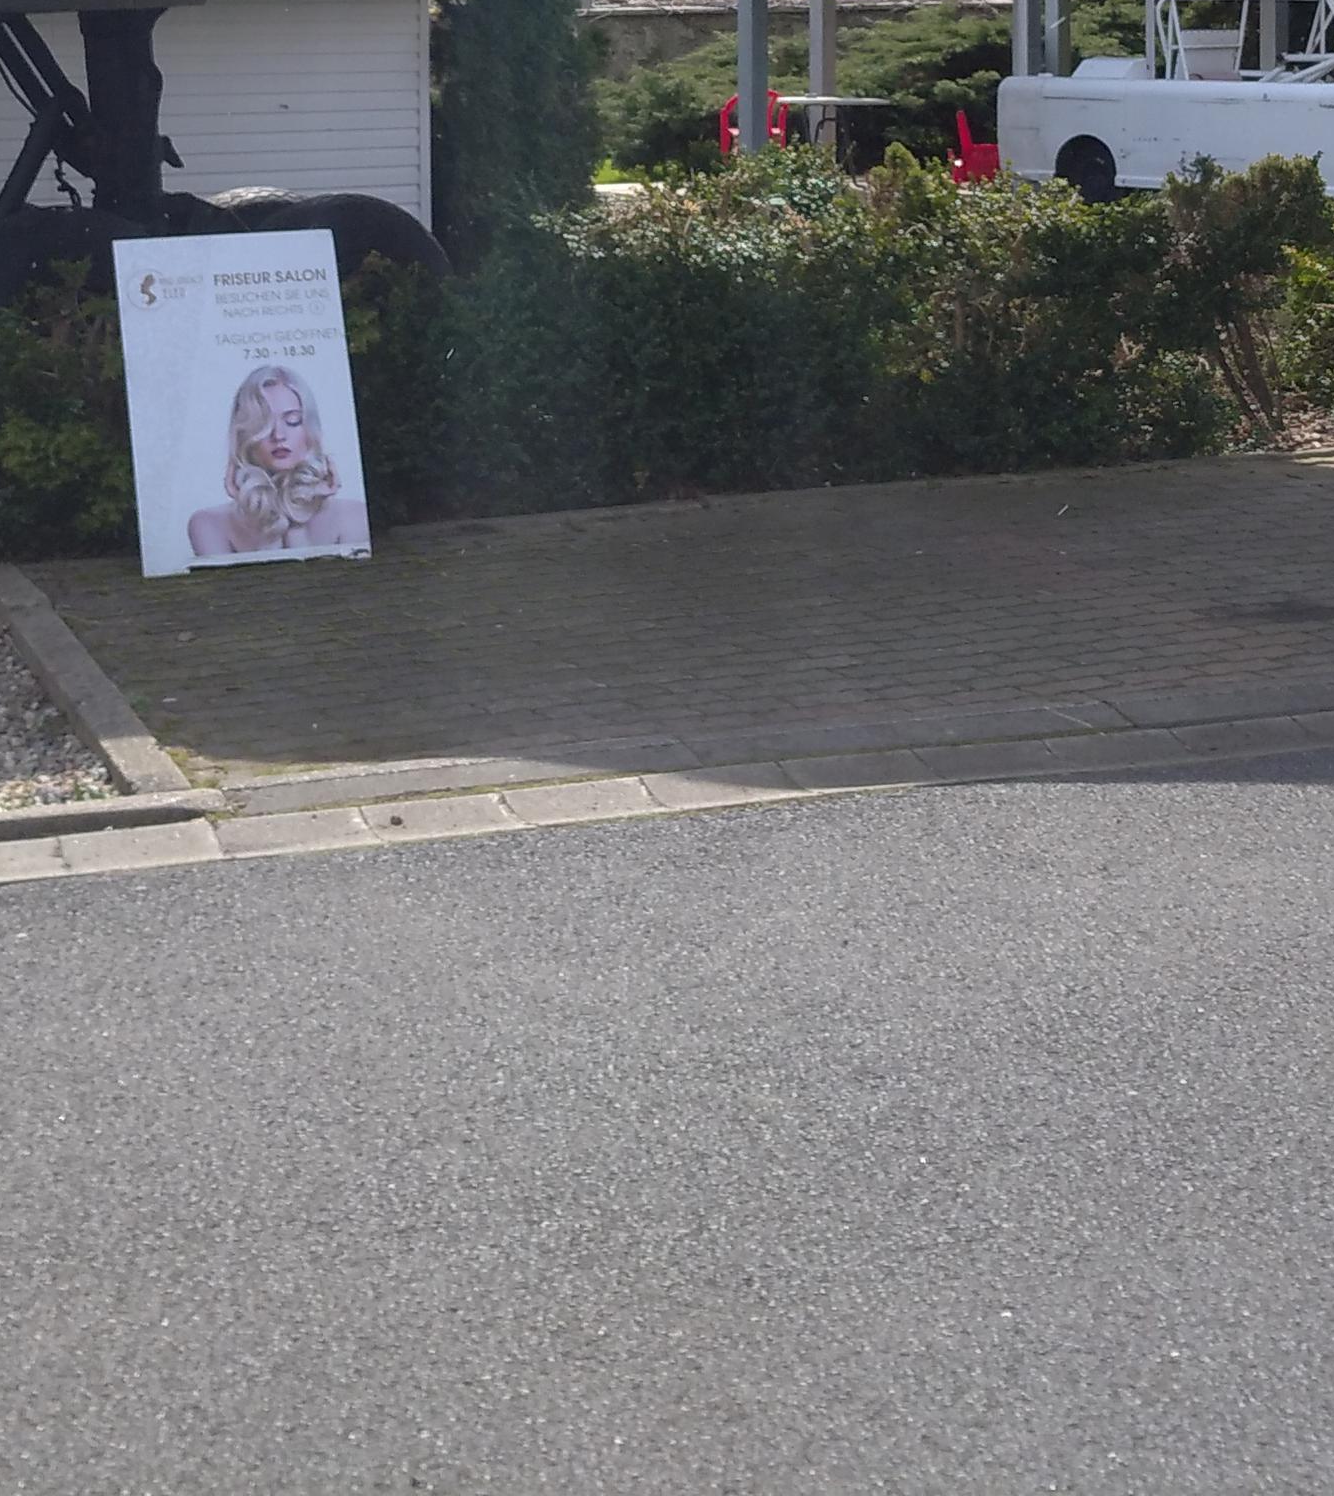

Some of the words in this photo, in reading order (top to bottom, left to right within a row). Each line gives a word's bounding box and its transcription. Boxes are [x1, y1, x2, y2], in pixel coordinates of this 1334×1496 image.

[213, 271, 271, 286] FRISEUR
[275, 268, 327, 283] SALON
[215, 290, 282, 305] BESUCHEN
[243, 347, 270, 360] 7.30
